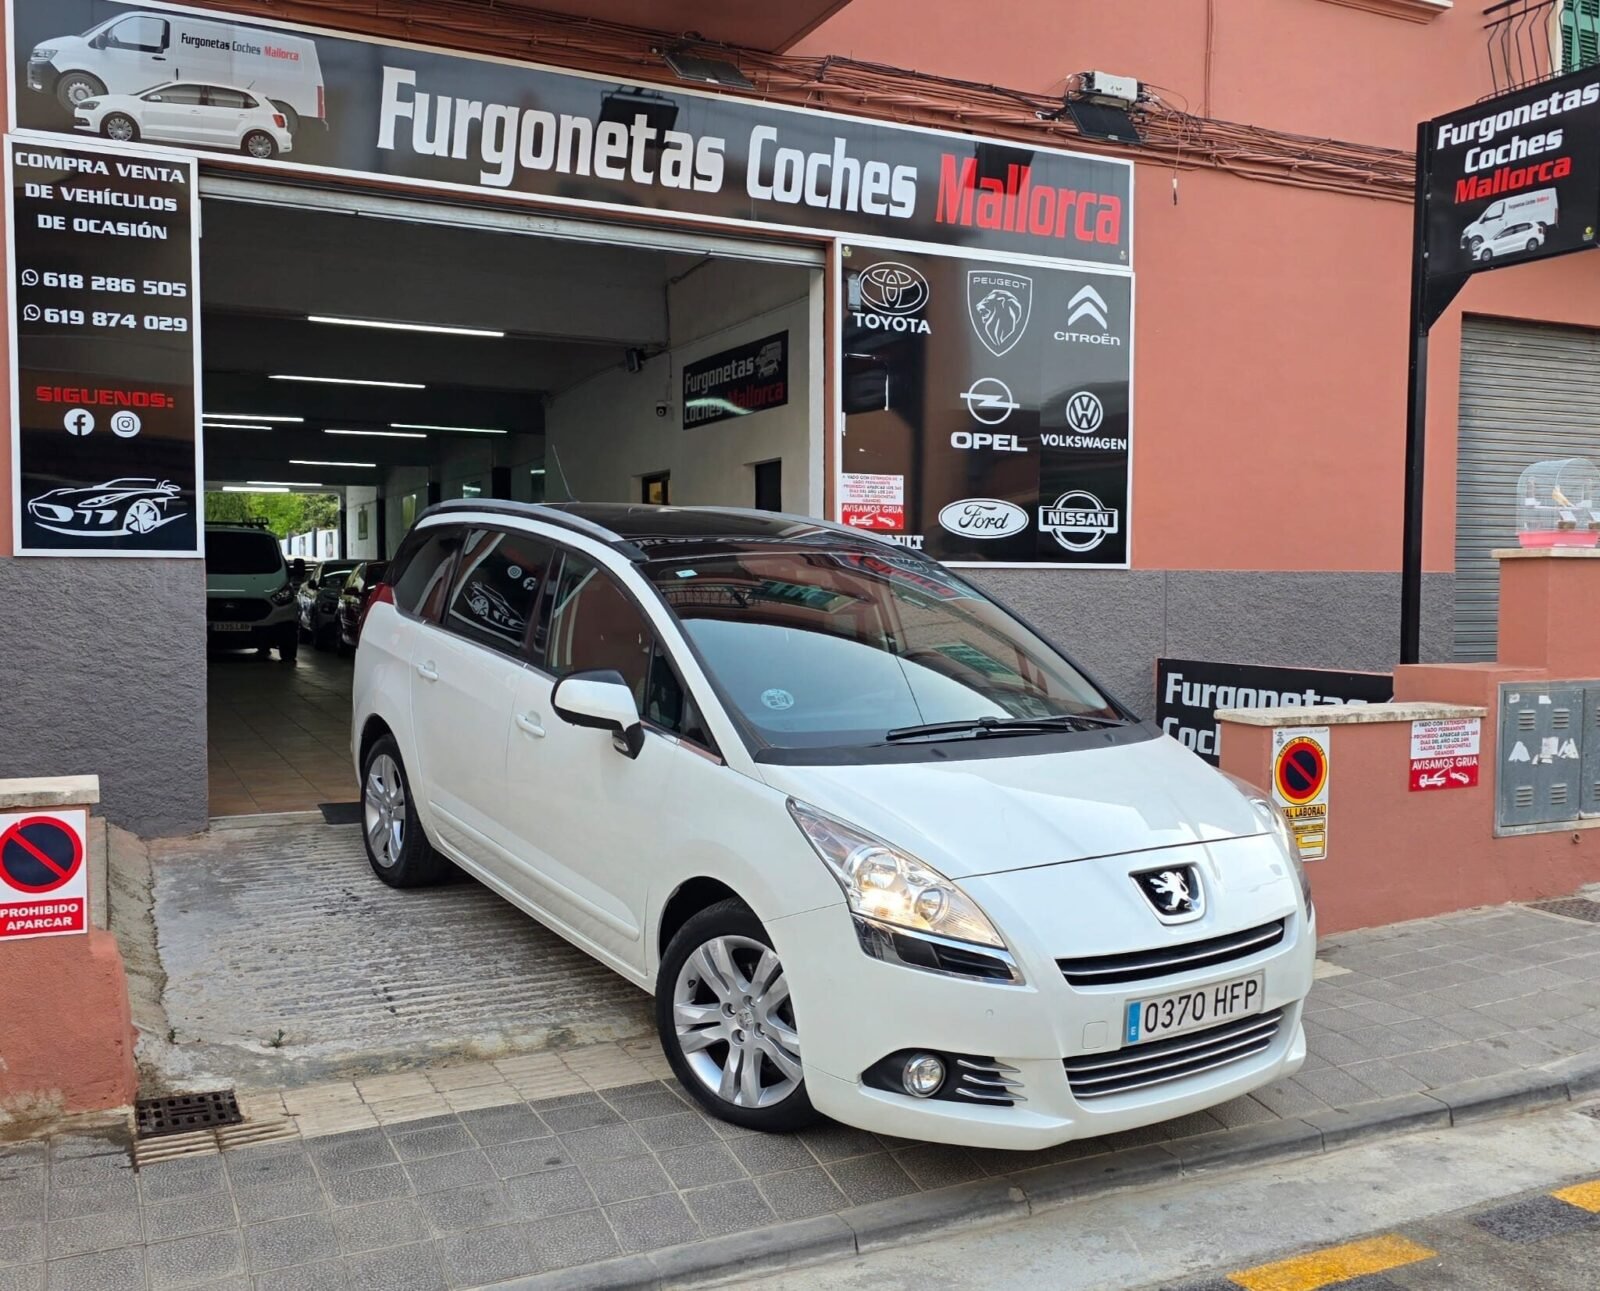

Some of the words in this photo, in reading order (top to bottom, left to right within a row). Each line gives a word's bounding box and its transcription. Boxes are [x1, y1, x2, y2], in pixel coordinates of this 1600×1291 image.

[181, 33, 231, 49] Furgonetas
[232, 41, 261, 55] Coches
[264, 46, 299, 61] Mallorca
[1437, 82, 1600, 150] Furgonetas
[376, 65, 726, 193] Furgonetas
[746, 124, 918, 219] Coches
[935, 153, 1121, 245] Mallorca
[1464, 128, 1563, 173] Coches
[15, 151, 110, 176] COMPRA
[115, 163, 186, 184] VENTA
[1454, 156, 1572, 204] Mallorca
[25, 183, 53, 199] DE
[60, 186, 178, 212] VEHÍCULOS
[37, 214, 66, 230] DE
[73, 218, 168, 240] OCASIÓN
[43, 272, 84, 289] 618
[91, 275, 136, 293] 286
[143, 279, 187, 297] 505
[972, 276, 1028, 290] PEUGEOT
[44, 308, 85, 325] 619
[92, 311, 137, 329] 874
[144, 315, 188, 332] 029
[852, 312, 932, 334] TOYOTA
[685, 357, 754, 394] Furgonetas
[36, 386, 174, 408] SIGUENOS:
[950, 432, 1028, 452] OPEL
[1040, 433, 1127, 450] VOLKSWAGEN
[842, 505, 880, 513] AVISAMOS
[882, 505, 903, 514] GRUA
[958, 505, 1009, 530] Ford
[1048, 511, 1109, 526] NISSAN
[1412, 758, 1454, 771] AVISAMOS
[1456, 756, 1478, 767] GRUA
[1295, 806, 1324, 818] LABORAL
[0, 903, 79, 918] PROHIBIDO
[6, 916, 73, 931] APARCAR
[1144, 992, 1206, 1033] 0370
[1213, 979, 1258, 1017] HFP
